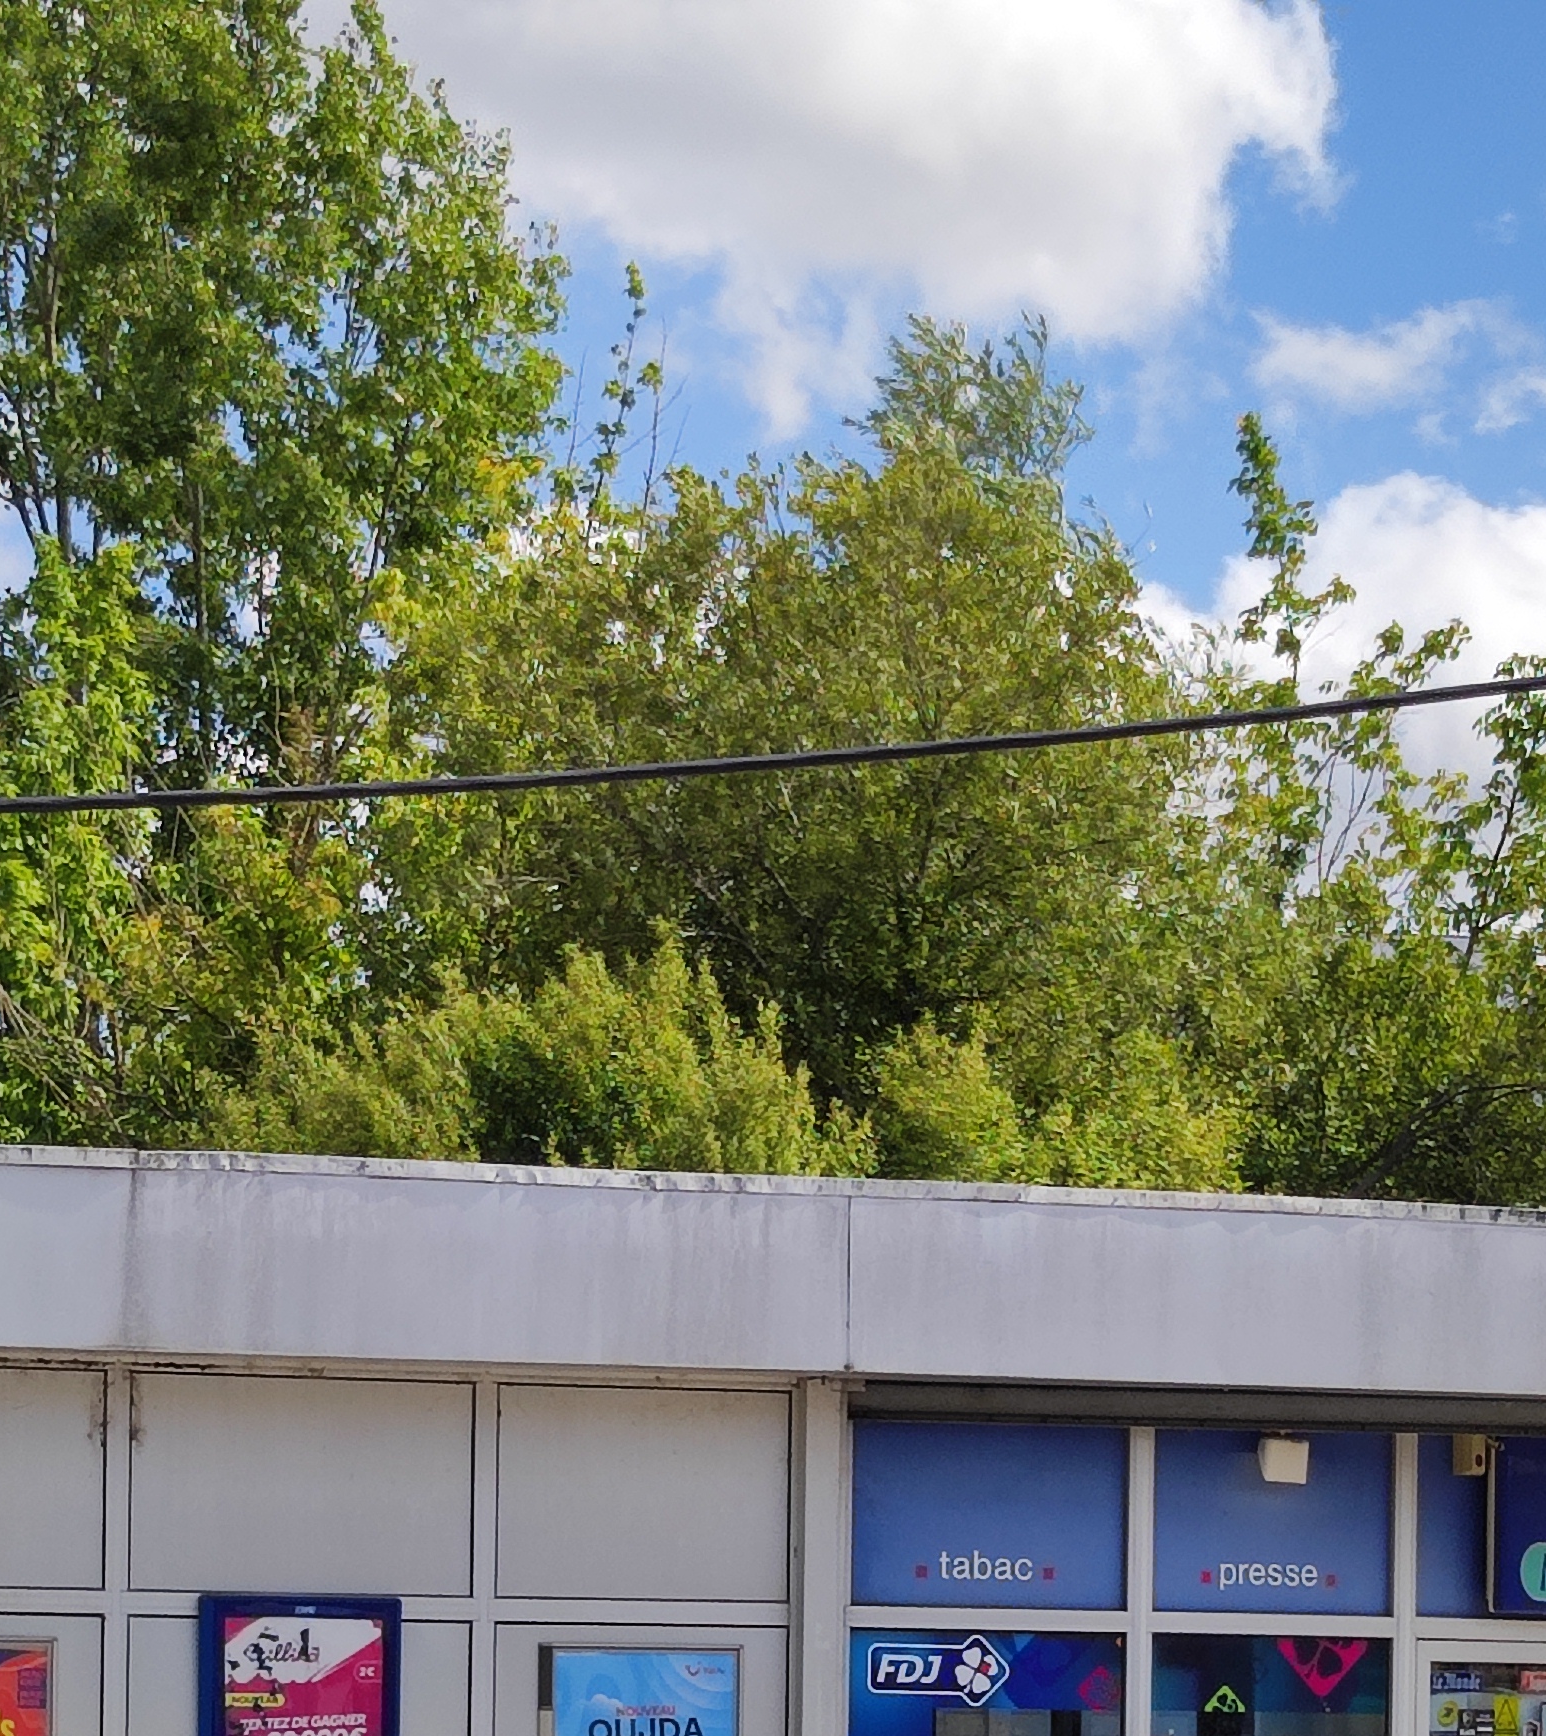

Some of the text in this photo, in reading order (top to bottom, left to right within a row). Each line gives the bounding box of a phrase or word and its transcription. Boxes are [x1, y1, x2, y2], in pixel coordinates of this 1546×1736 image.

[939, 1550, 1033, 1581] tabac
[1219, 1563, 1319, 1591] presse
[876, 1653, 943, 1684] FDJ
[292, 1715, 310, 1728] DE
[311, 1713, 367, 1728] GAGNER
